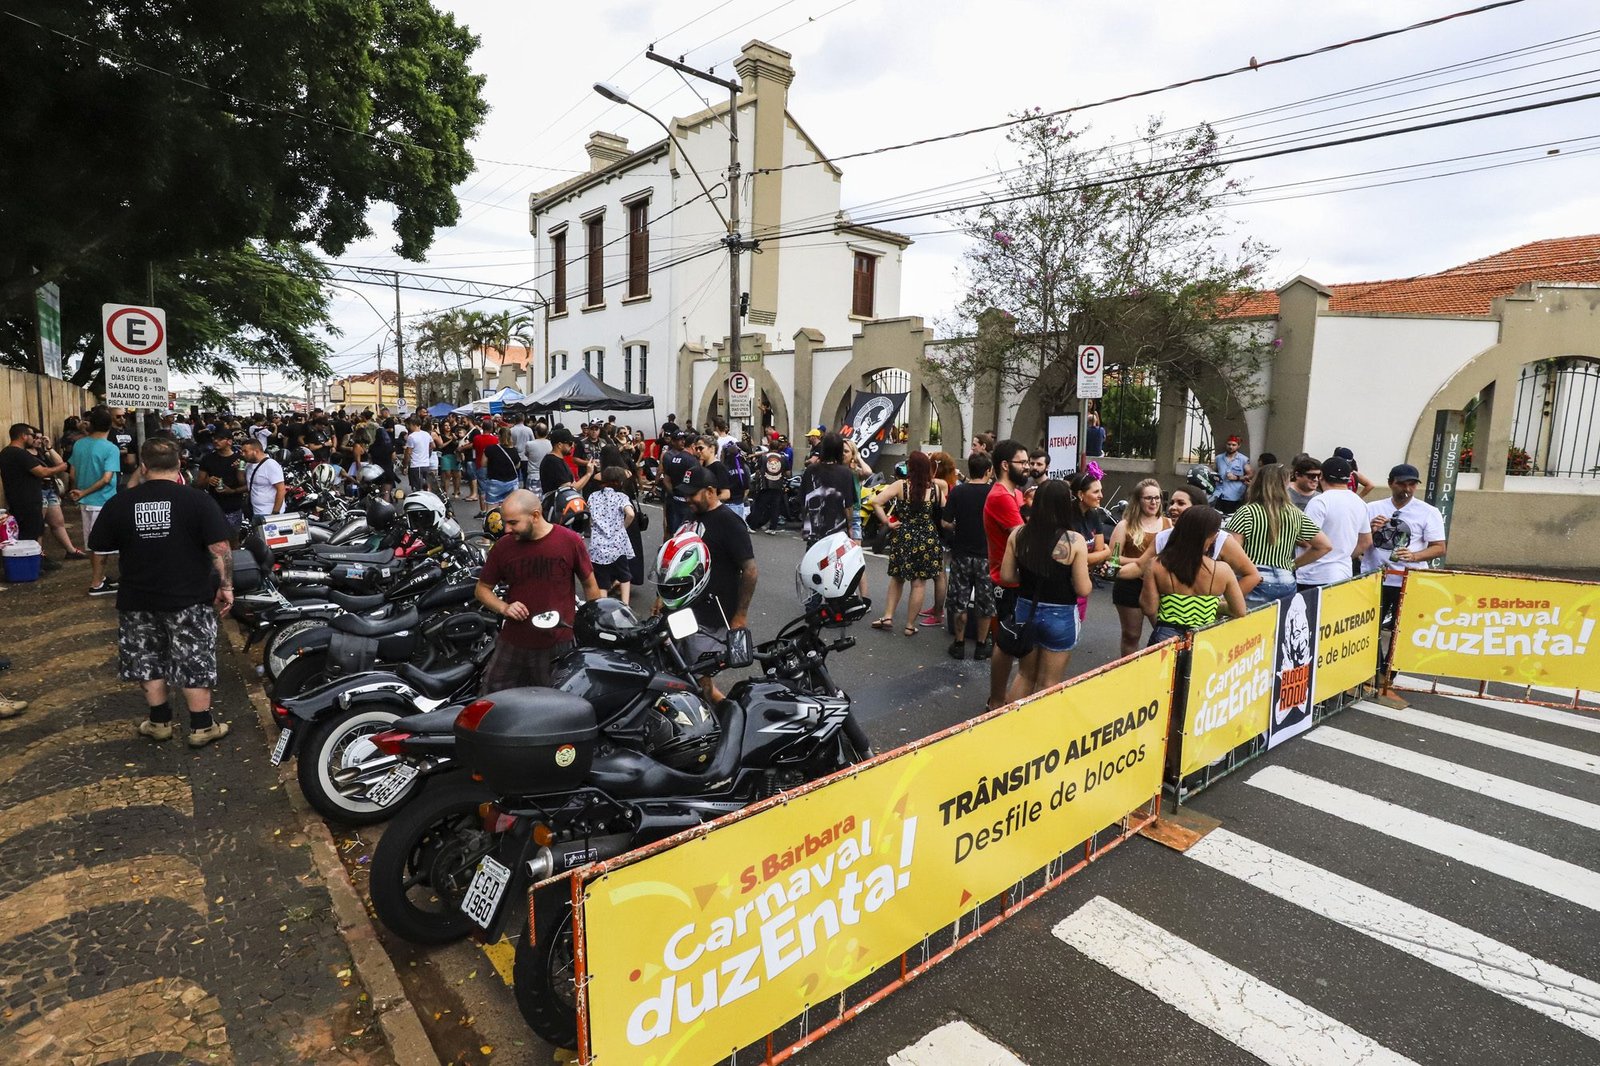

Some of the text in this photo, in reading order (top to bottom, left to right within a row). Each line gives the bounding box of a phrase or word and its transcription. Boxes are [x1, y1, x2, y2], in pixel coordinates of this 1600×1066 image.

[126, 318, 146, 346] E
[110, 355, 118, 363] NA
[139, 357, 163, 366] BRANCA
[1086, 353, 1094, 368] E
[736, 377, 743, 389] E
[146, 400, 167, 408] ATIVADO
[1049, 434, 1077, 449] ATENÇÃO
[1427, 433, 1442, 500] MUSEU DA
[1441, 433, 1458, 501] MUSEU DA
[136, 502, 159, 511] BLOCO
[136, 511, 170, 524] ROQUE
[1333, 608, 1375, 636] ALTERADO
[1434, 606, 1561, 628] Carnaval
[1326, 646, 1338, 665] de
[1341, 636, 1370, 659] blocos
[1411, 618, 1596, 656] duzEnta!
[1206, 638, 1266, 699] Carnaval
[1281, 668, 1303, 687] BLOCO
[938, 699, 1159, 827] TRÂNSITO ALTERADO
[955, 744, 1145, 864] Desfile de blocos
[475, 871, 500, 900] CGD
[663, 819, 872, 972] Carnaval
[466, 891, 492, 922] 1960
[625, 815, 918, 1046] duzEnta!
